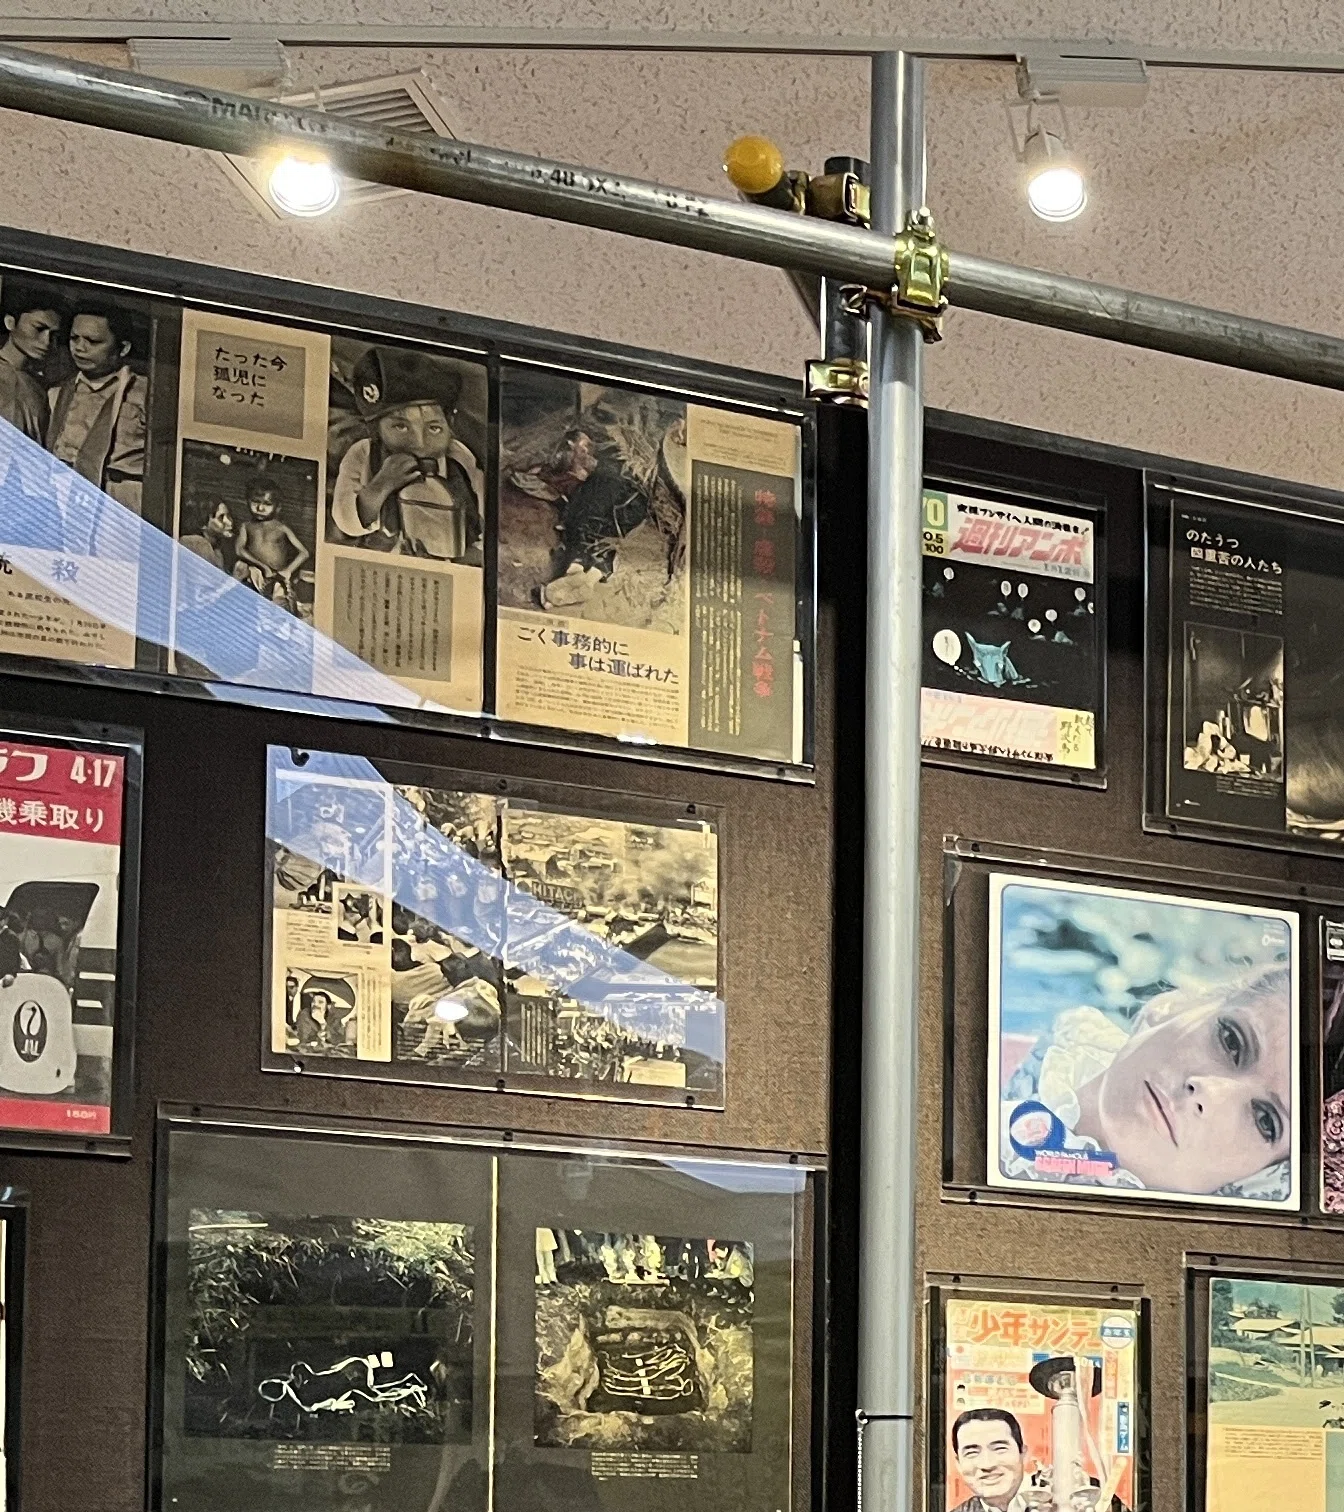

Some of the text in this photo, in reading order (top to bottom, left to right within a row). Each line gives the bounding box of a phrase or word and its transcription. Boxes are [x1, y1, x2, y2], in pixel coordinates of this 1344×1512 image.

[214, 346, 288, 372] たった今
[212, 366, 267, 389] 孤児に
[212, 385, 266, 408] なった
[950, 517, 1088, 565] 週刊アンポ
[1186, 528, 1240, 550] のたうつ
[517, 625, 630, 657] ごく事務的に
[568, 652, 680, 685] 事は運ばれた
[969, 1308, 1103, 1350] 少年サンデー
